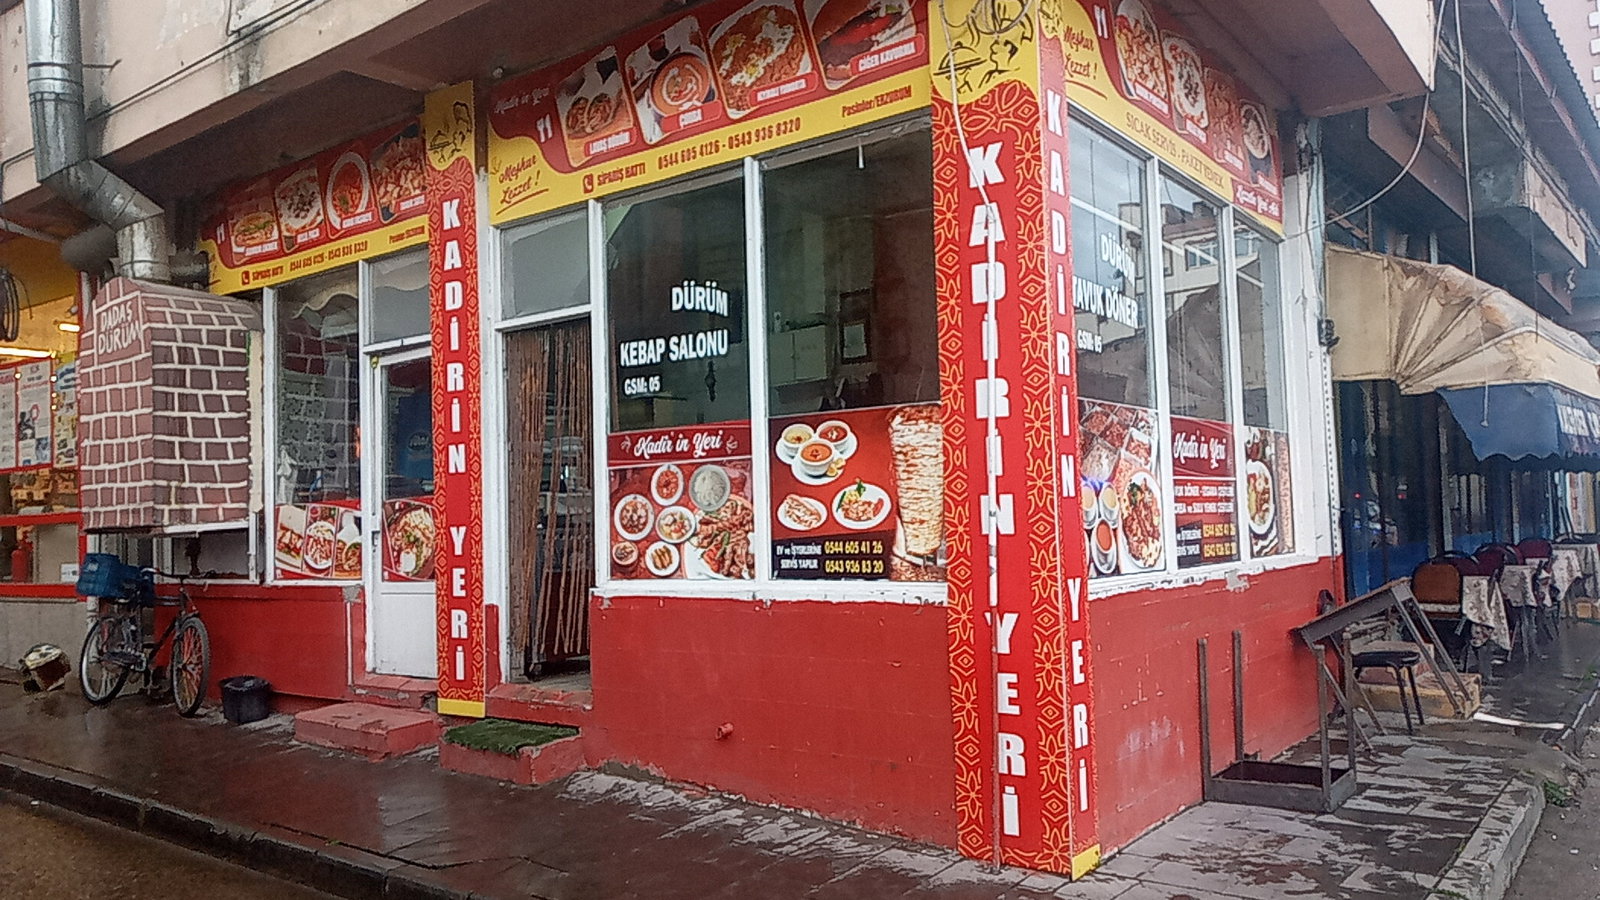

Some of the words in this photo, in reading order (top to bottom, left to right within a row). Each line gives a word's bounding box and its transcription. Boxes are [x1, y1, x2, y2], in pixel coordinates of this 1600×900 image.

[657, 153, 679, 170] 0544
[681, 149, 697, 164] 605
[728, 131, 752, 150] 0543
[754, 124, 774, 143] 936
[775, 116, 801, 137] 8320
[671, 280, 728, 317] DÜRÜM
[1105, 285, 1138, 329] DÖNER
[620, 338, 666, 367] KEBAP
[669, 329, 728, 361] SALONU
[624, 377, 647, 395] GSM:
[648, 375, 660, 393] 05
[693, 430, 723, 458] Yeri
[824, 541, 844, 554] 0544
[845, 541, 860, 554] 605
[861, 541, 870, 554] 41
[872, 540, 883, 554] 26
[825, 560, 844, 573] 0543
[845, 560, 860, 573] 936
[861, 560, 871, 573] 83
[873, 560, 884, 573] 20
[449, 525, 468, 681] YERİ
[1066, 577, 1089, 813] YERİ
[984, 612, 1026, 838] YERİ
